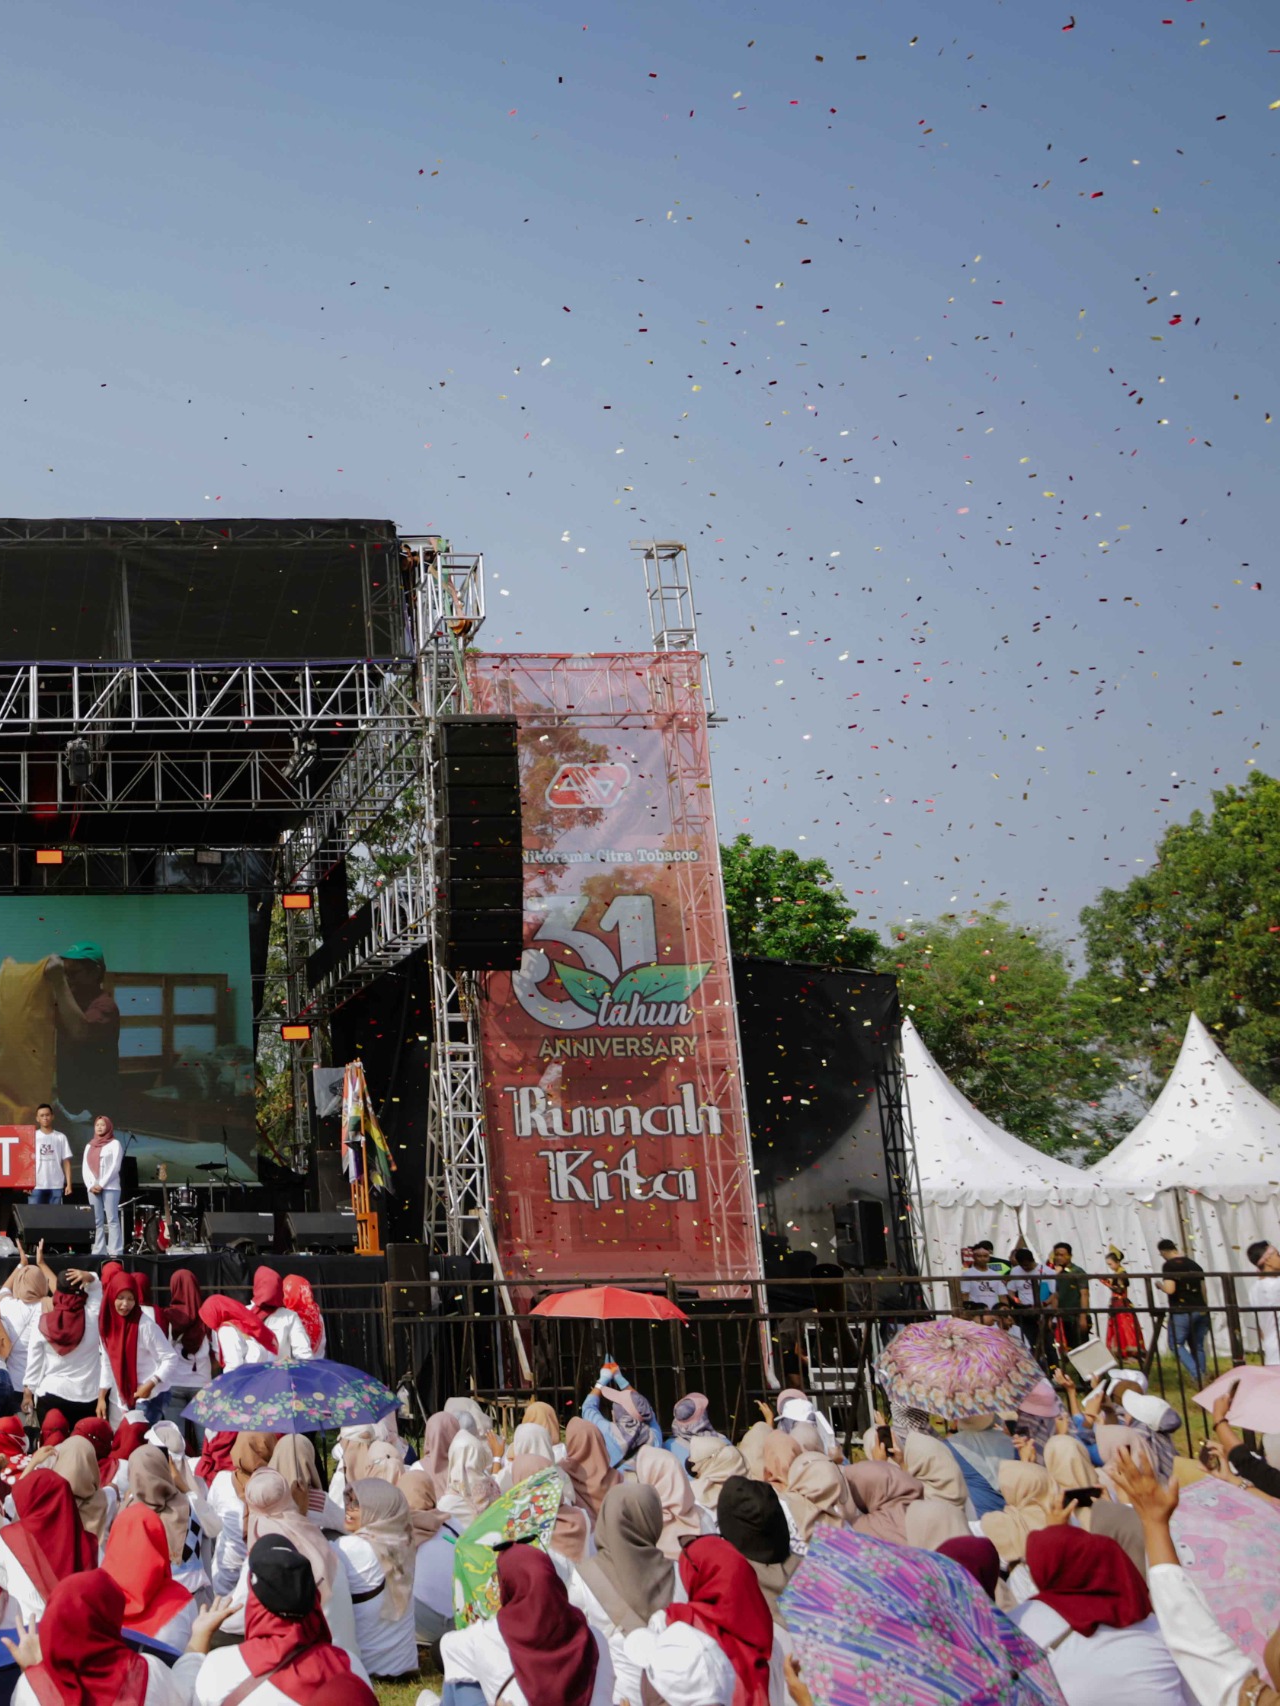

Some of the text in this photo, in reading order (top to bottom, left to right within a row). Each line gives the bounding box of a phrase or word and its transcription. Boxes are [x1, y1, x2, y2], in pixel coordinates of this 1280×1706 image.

[596, 850, 632, 863] Citra
[637, 850, 698, 862] Tobacco
[597, 992, 695, 1028] tahun
[538, 1036, 699, 1060] ANNIVERSARY
[503, 1082, 722, 1138] Rumah
[537, 1148, 698, 1208] Kita
